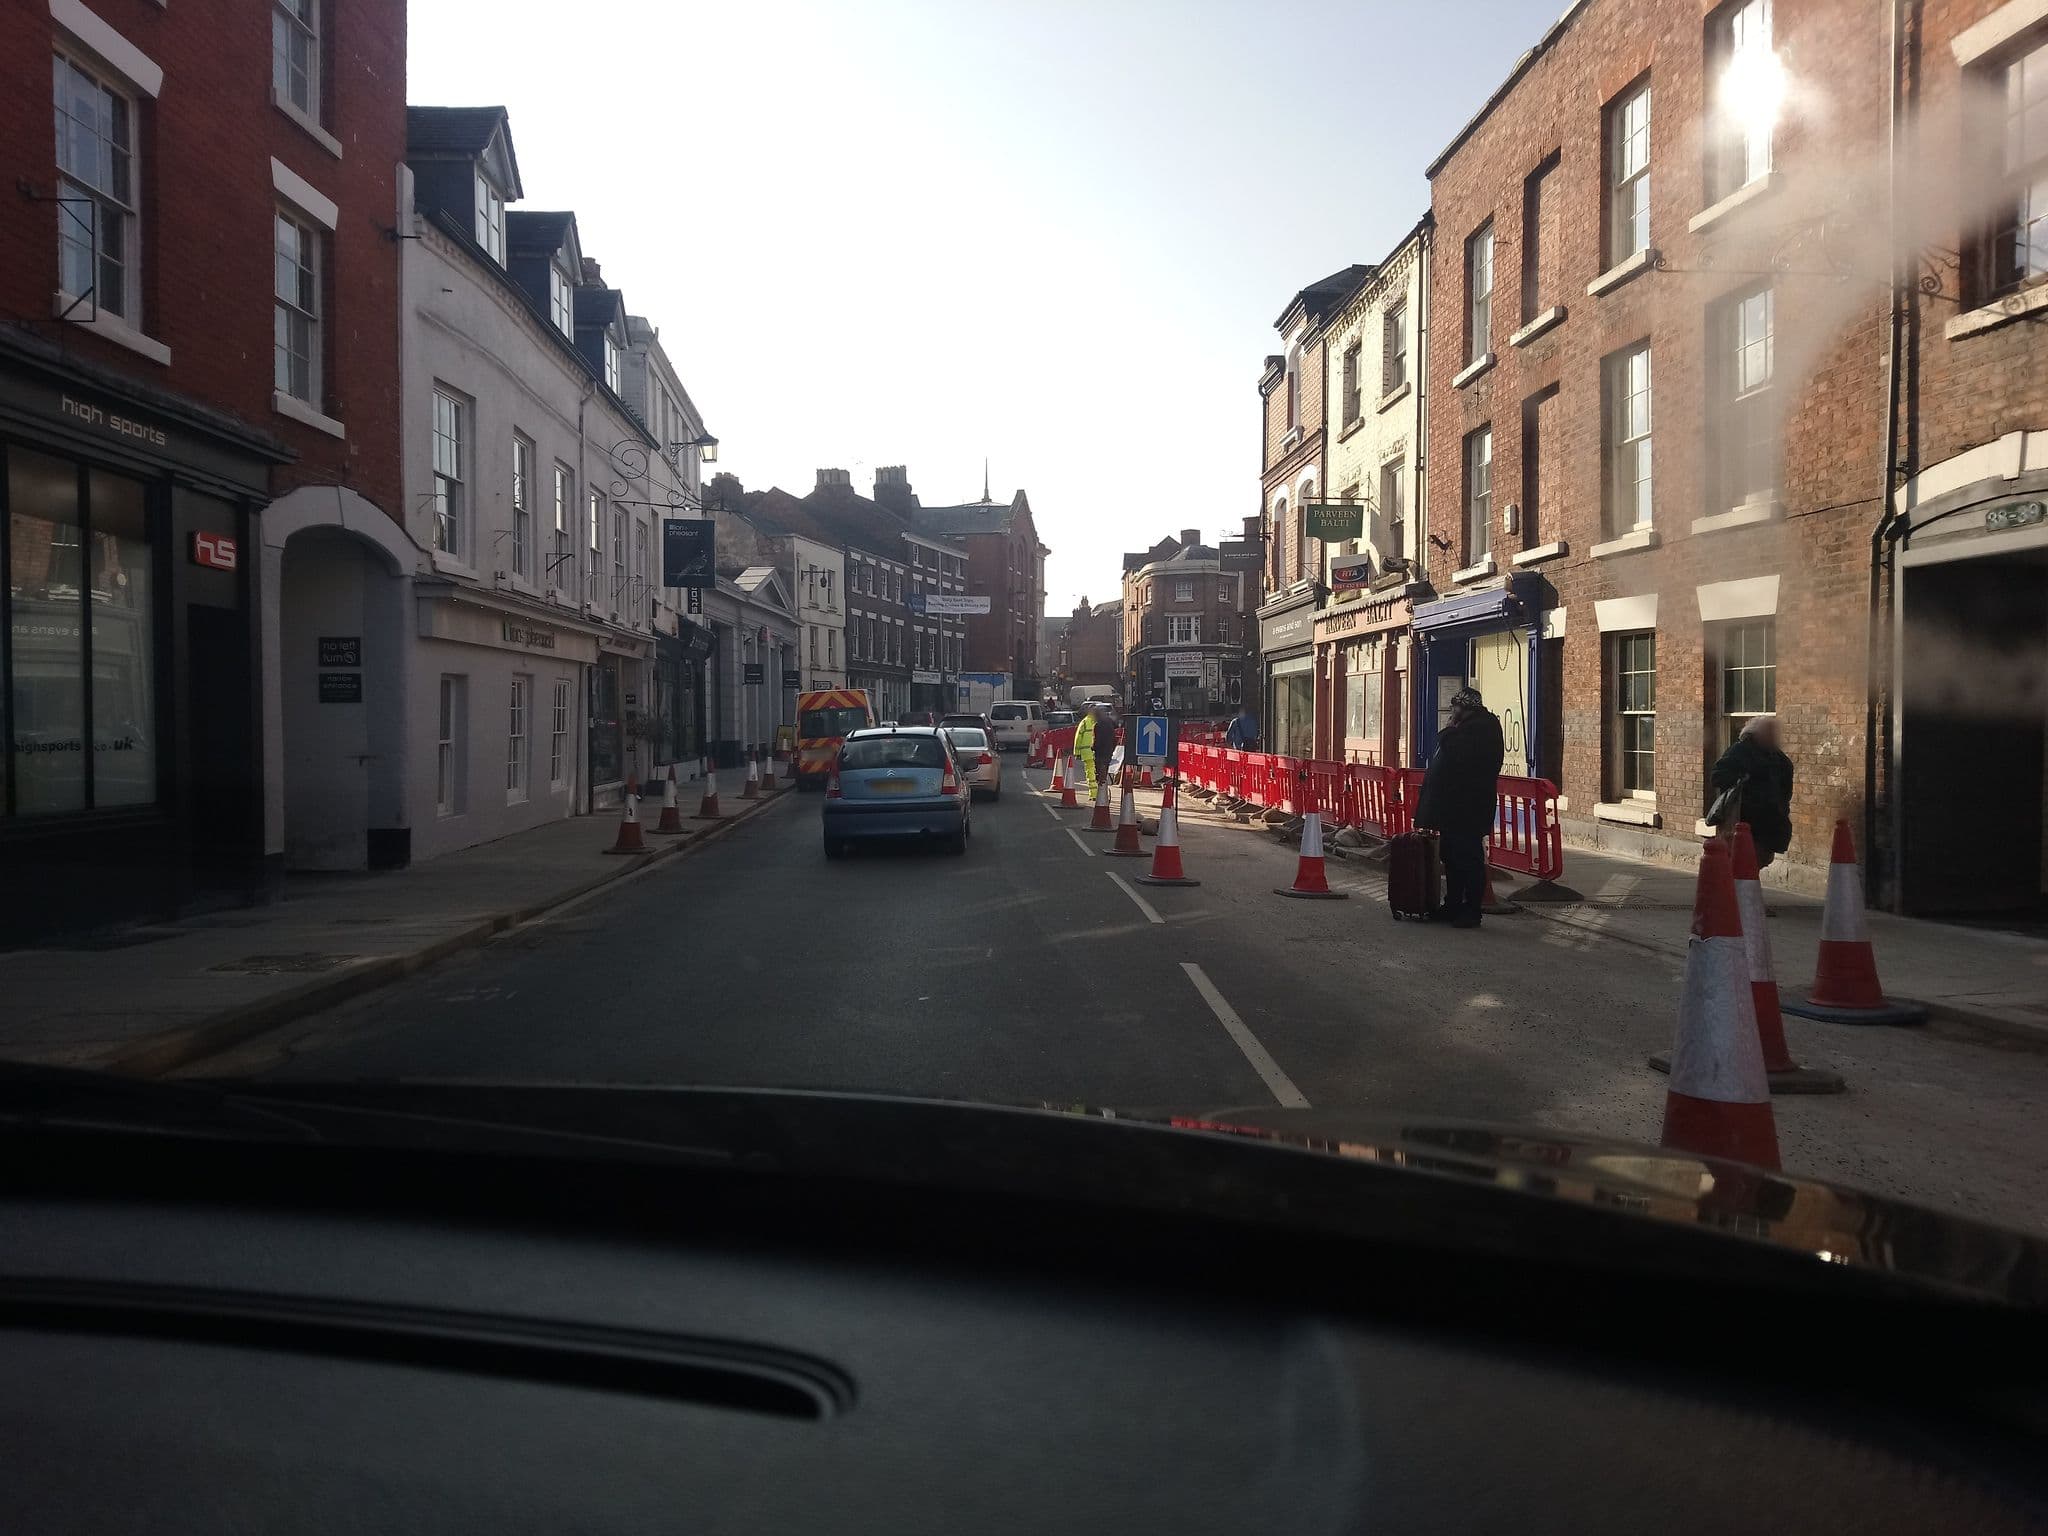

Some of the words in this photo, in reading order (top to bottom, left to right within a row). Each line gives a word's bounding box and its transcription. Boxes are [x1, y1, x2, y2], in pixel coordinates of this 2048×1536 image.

[62, 394, 103, 424] high
[110, 416, 166, 446] sports
[1314, 510, 1358, 519] PARVEEN
[1320, 519, 1350, 527] BALTI
[196, 532, 236, 568] hs
[1342, 569, 1358, 577] RTA
[1325, 613, 1357, 635] PARVEEN
[1366, 603, 1393, 625] BALTI
[1504, 708, 1520, 752] Co
